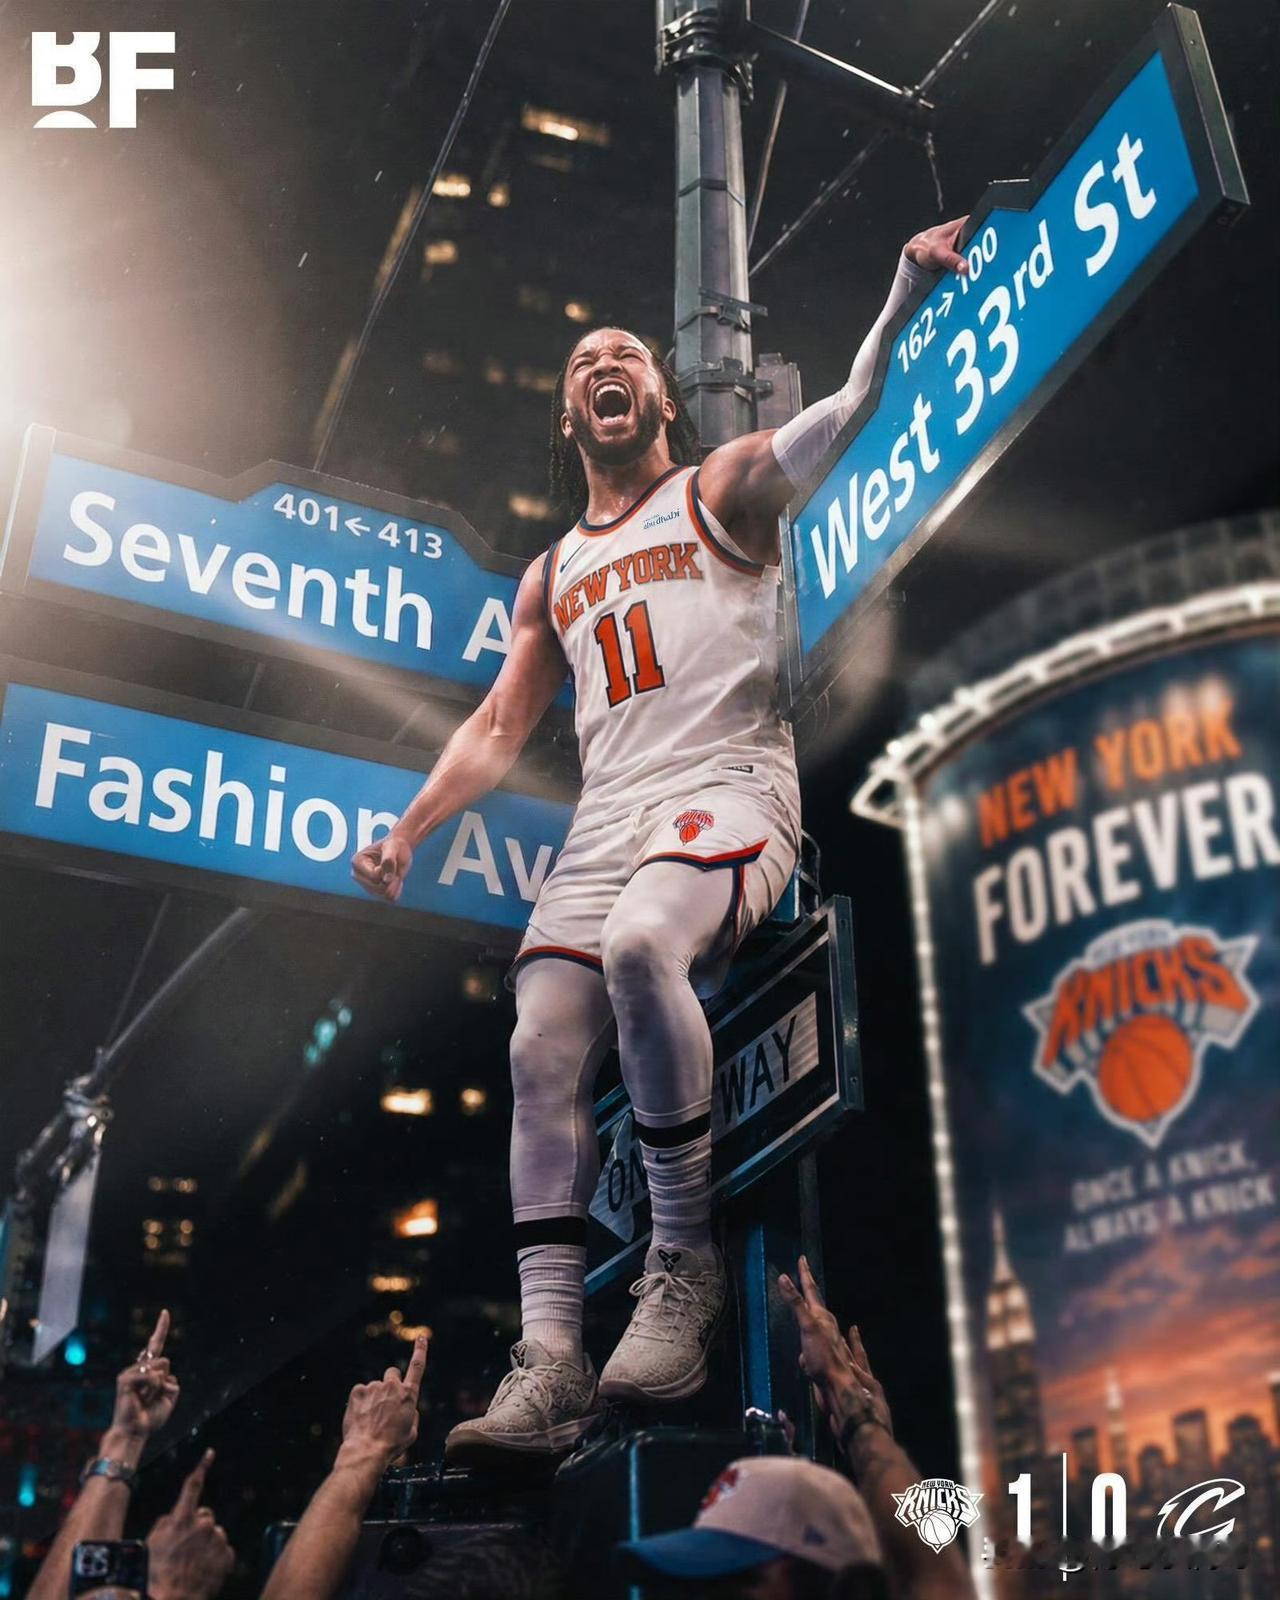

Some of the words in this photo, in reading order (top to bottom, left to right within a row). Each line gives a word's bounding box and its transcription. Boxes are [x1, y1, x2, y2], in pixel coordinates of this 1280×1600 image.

[810, 392, 941, 600] West
[946, 219, 1054, 435] 33rd
[1073, 132, 1158, 277] St
[898, 306, 937, 374] 162
[62, 490, 433, 651] Seventh
[273, 492, 340, 532] 401
[377, 520, 443, 560] 413
[553, 565, 610, 637] NEW
[612, 542, 704, 593] YORK
[593, 599, 666, 708] 11
[34, 721, 401, 863] Fashion
[979, 747, 1078, 849] NEW
[1093, 684, 1242, 792] YORK
[973, 771, 1280, 967] FOREVER
[1041, 934, 1250, 1068] KNICKS
[718, 1013, 797, 1124] WAY
